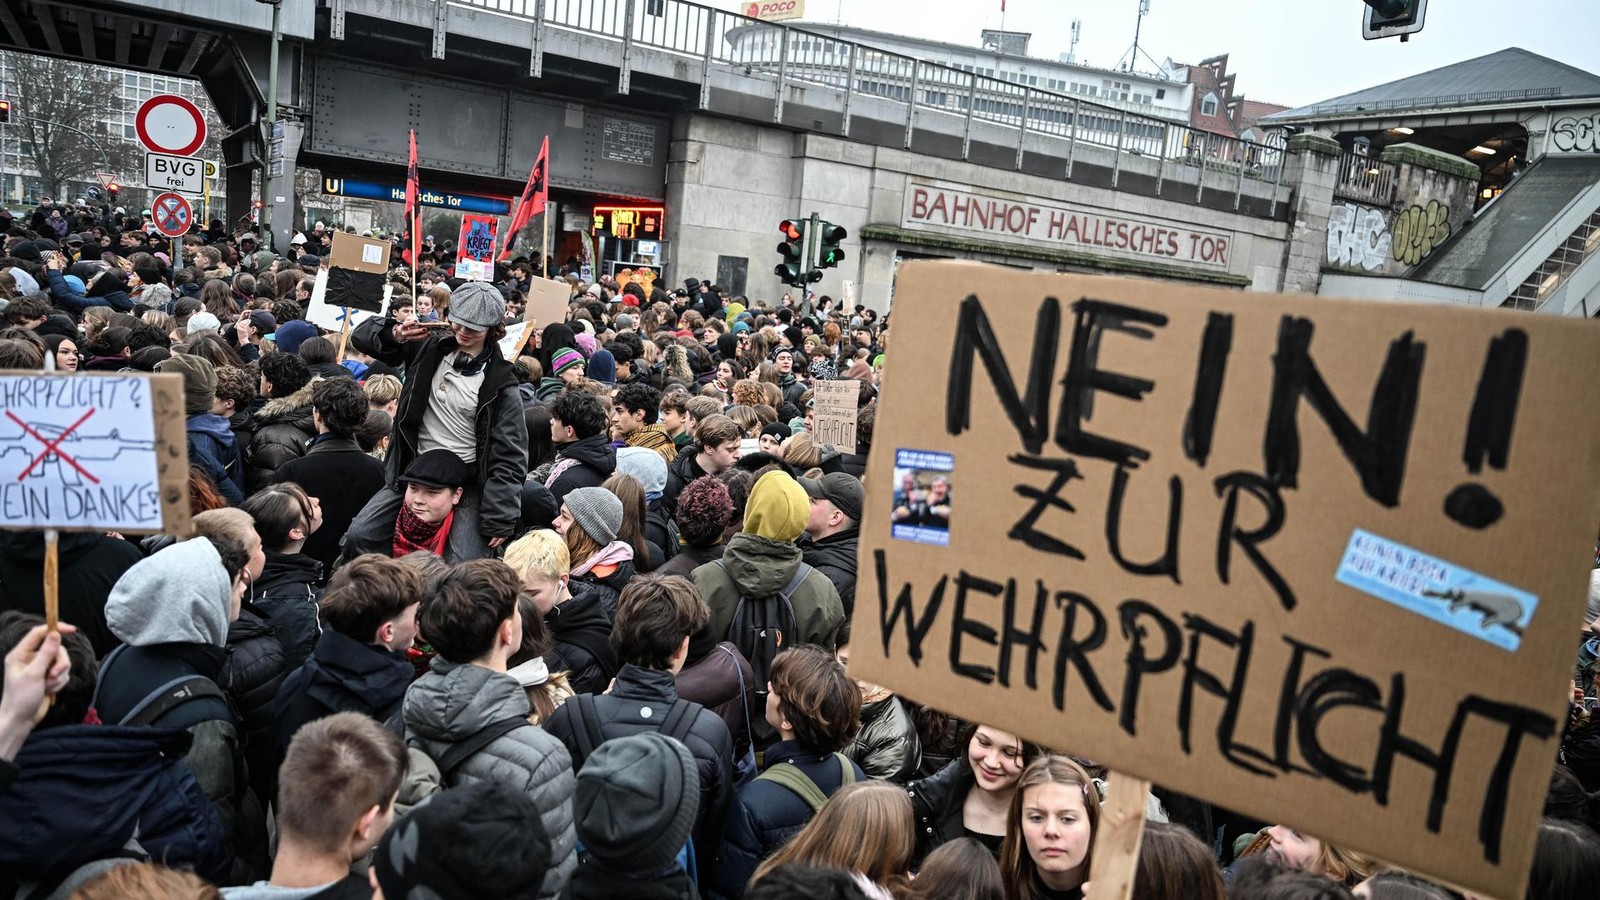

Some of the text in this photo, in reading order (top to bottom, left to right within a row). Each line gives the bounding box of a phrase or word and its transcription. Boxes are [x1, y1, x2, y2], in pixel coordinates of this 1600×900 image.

[760, 1, 796, 15] POCO
[155, 159, 196, 176] BVG
[166, 176, 184, 187] frei
[325, 178, 339, 193] U
[391, 188, 462, 207] Hasches Tor
[911, 188, 1227, 264] BAHNHOF HALLESCHES TOR
[466, 236, 493, 250] KRIEGT
[946, 293, 1529, 529] NEIN!
[0, 482, 49, 521] EIN
[1007, 453, 1297, 611] ZUR
[873, 548, 1557, 865] WEHRPFLICHT
